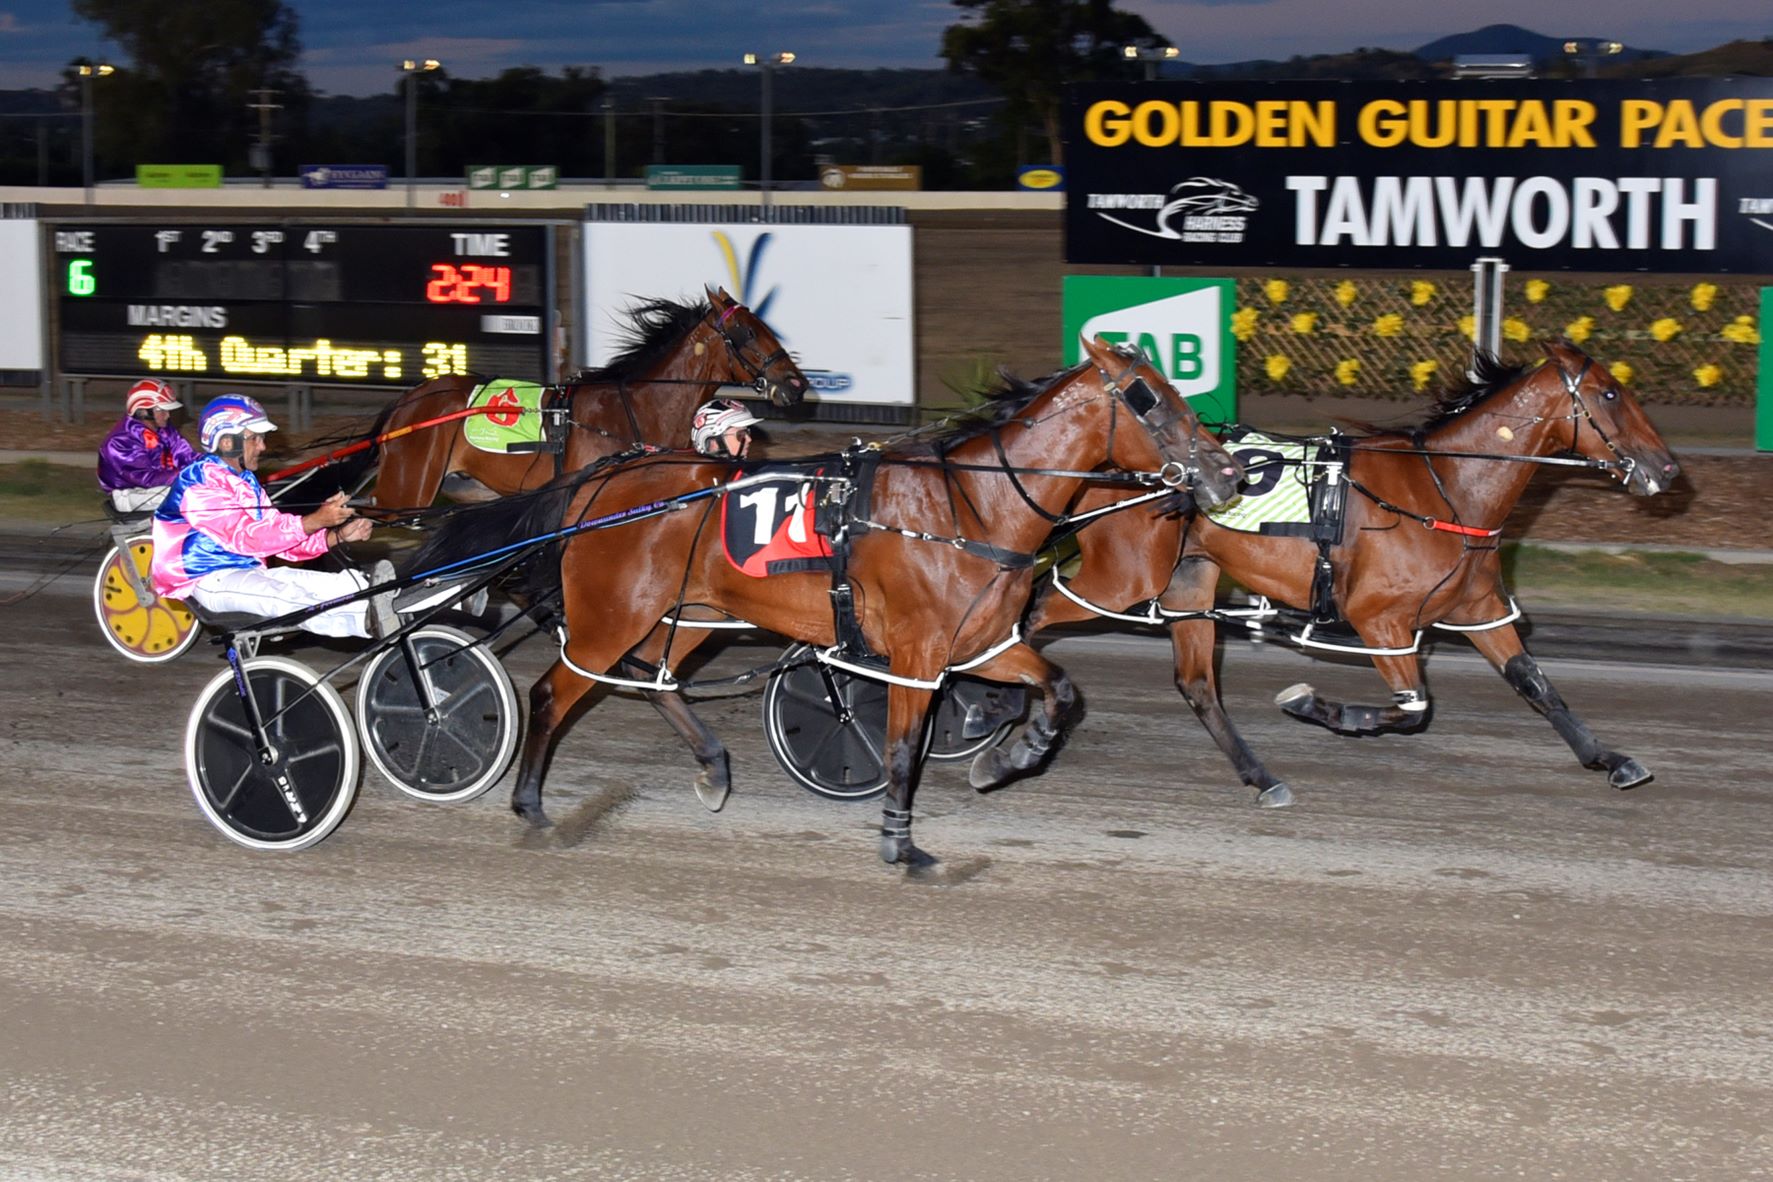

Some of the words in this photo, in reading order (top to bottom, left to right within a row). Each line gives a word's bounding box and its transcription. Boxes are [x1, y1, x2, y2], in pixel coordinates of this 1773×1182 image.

[1084, 100, 1336, 148] GOLDEN
[1358, 99, 1598, 148] GUITAR
[1087, 194, 1166, 209] TAMWORTH
[1286, 175, 1717, 250] TAMWORTH
[1183, 216, 1247, 231] HARNESS
[450, 233, 511, 256] TIME
[69, 260, 95, 295] 6
[127, 305, 228, 328] MARGINS
[138, 335, 207, 371] 4th
[486, 387, 519, 428] 6
[740, 482, 811, 545] 11
